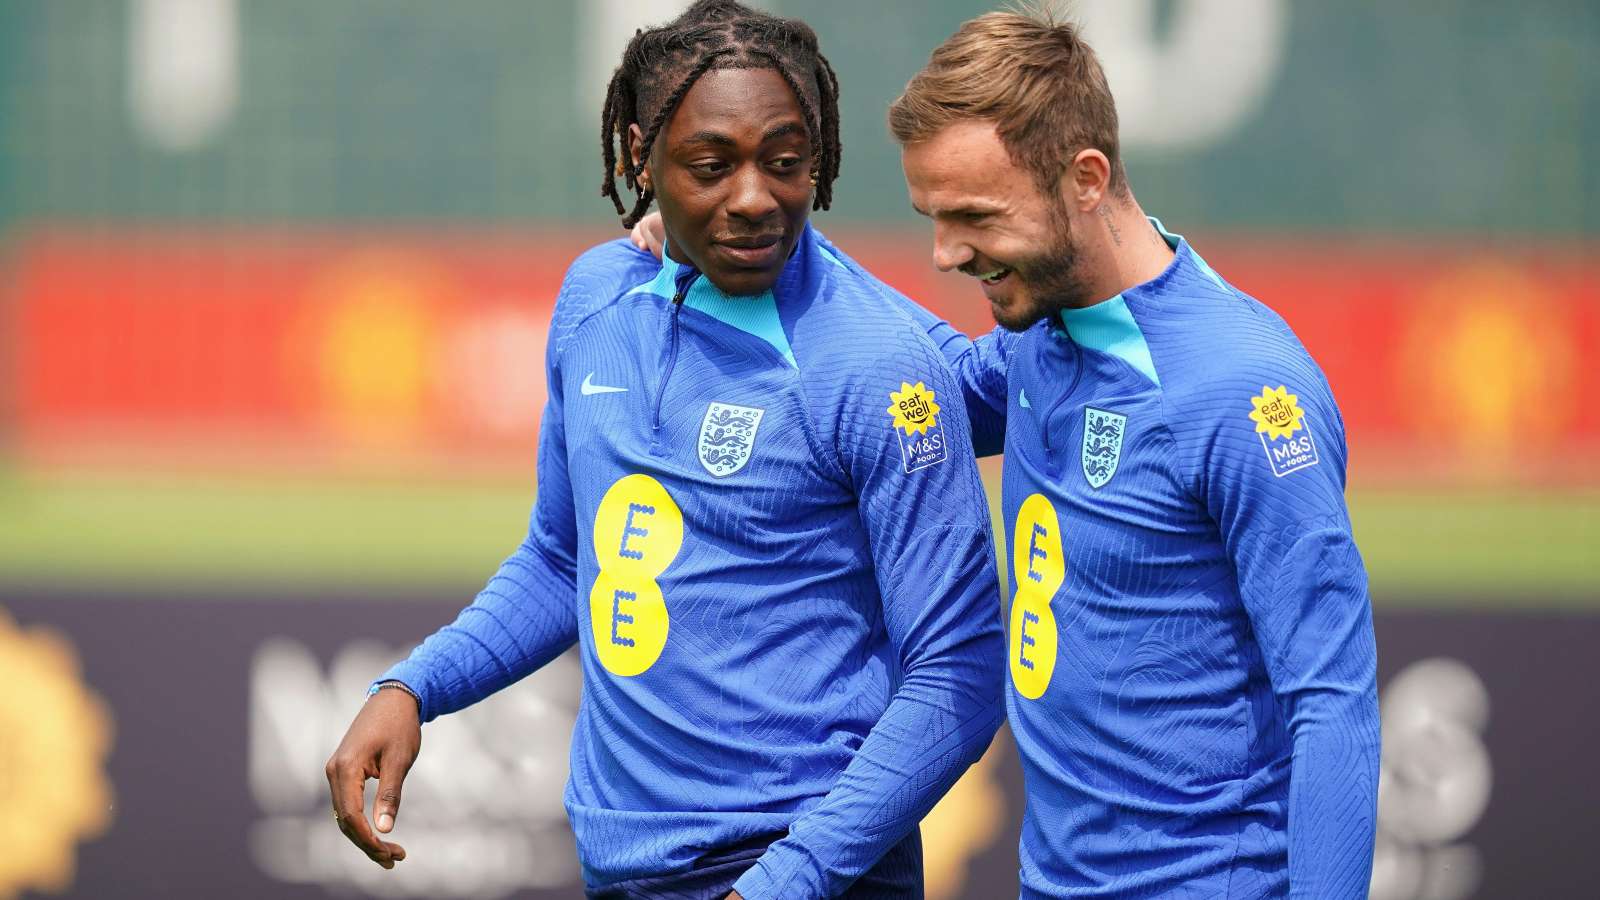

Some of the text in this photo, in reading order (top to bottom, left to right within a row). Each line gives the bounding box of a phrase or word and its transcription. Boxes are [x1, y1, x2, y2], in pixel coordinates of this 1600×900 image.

[899, 393, 921, 411] eat
[904, 400, 931, 420] well
[1261, 397, 1282, 415] eat
[1265, 404, 1293, 424] well
[907, 434, 941, 458] M&S
[1273, 436, 1311, 462] M&S
[917, 453, 936, 464] FOOD
